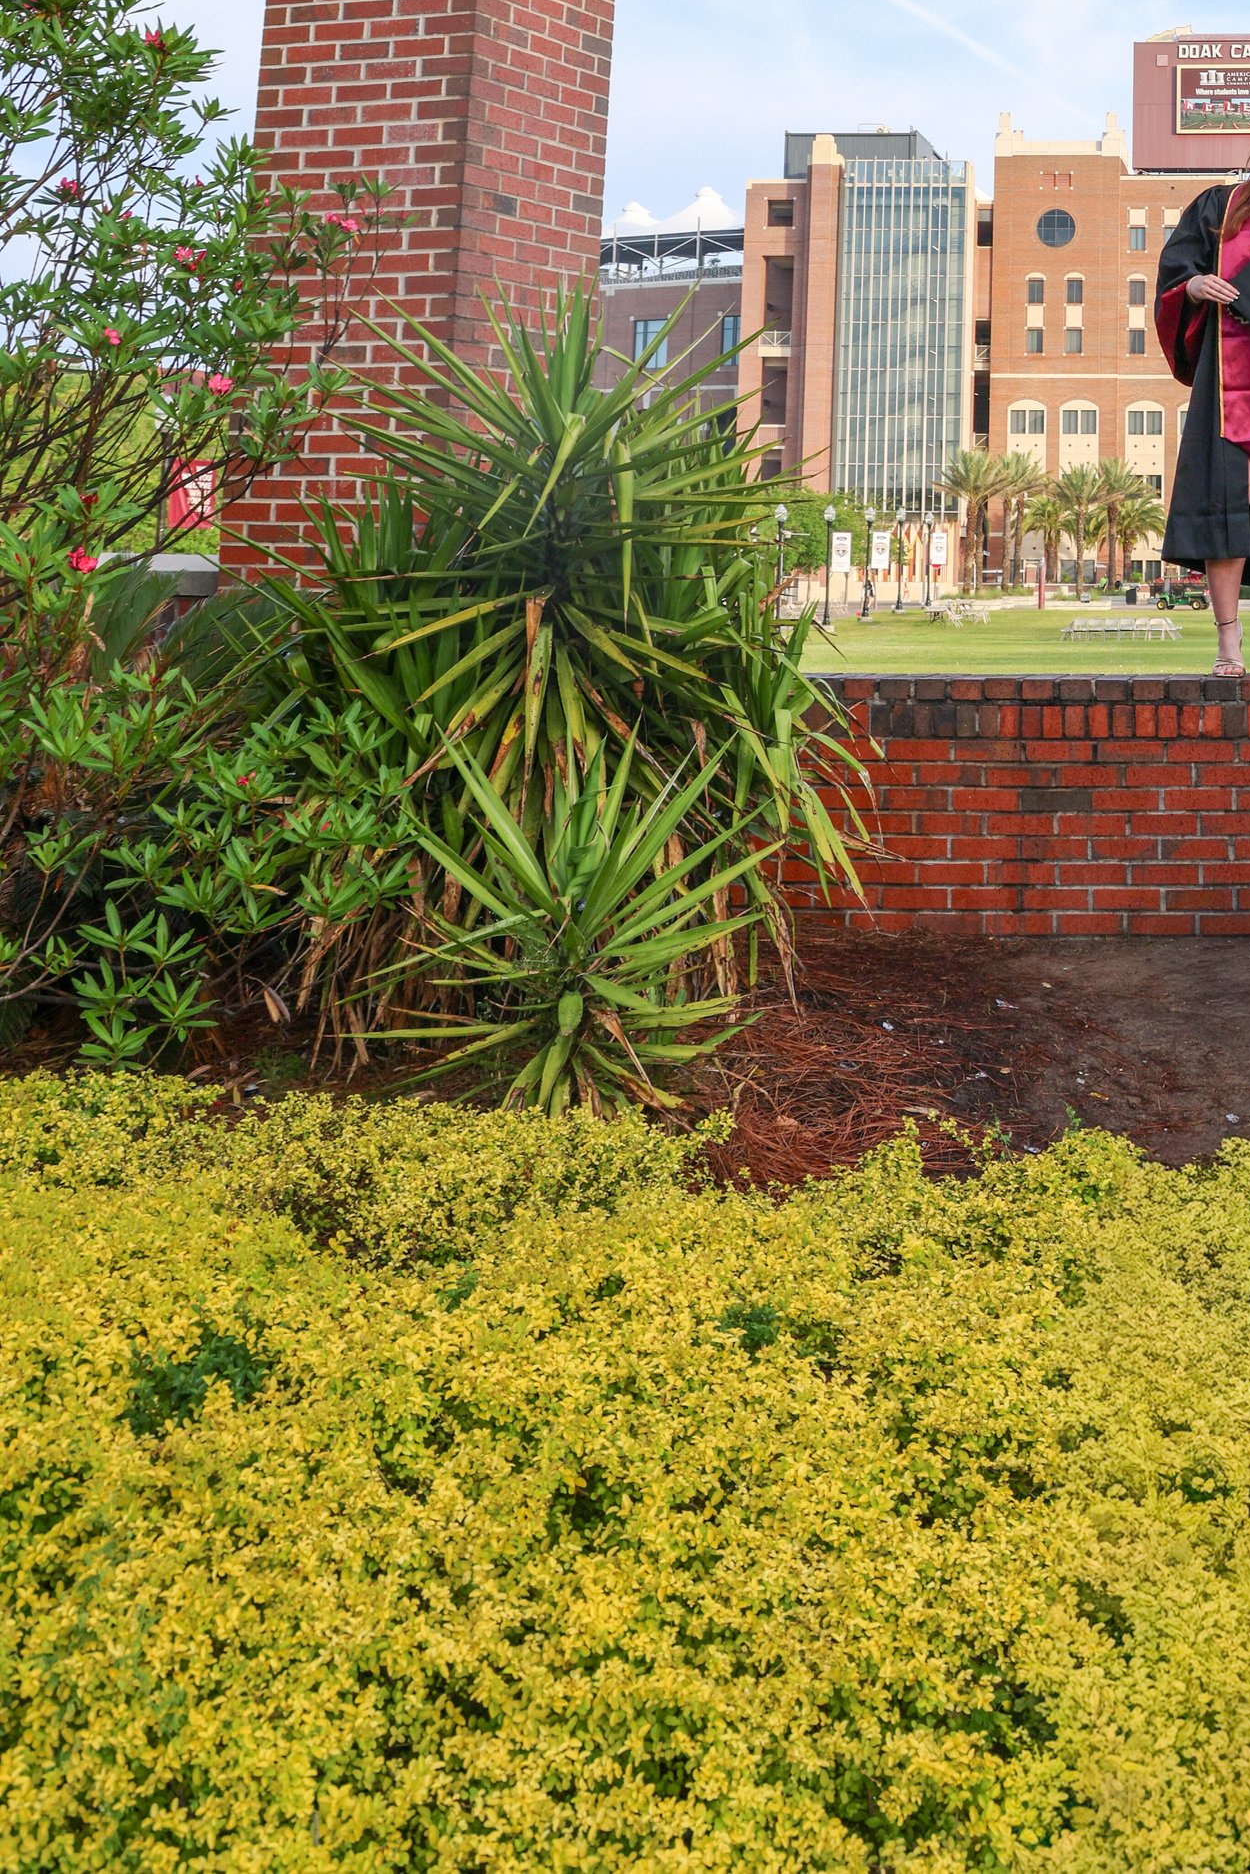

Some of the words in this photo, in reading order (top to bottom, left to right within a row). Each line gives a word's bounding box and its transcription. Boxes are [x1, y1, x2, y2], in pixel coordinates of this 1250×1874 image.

[1177, 44, 1223, 59] DOAK
[1195, 88, 1214, 96] Where
[1214, 88, 1237, 96] students
[1237, 88, 1249, 96] love
